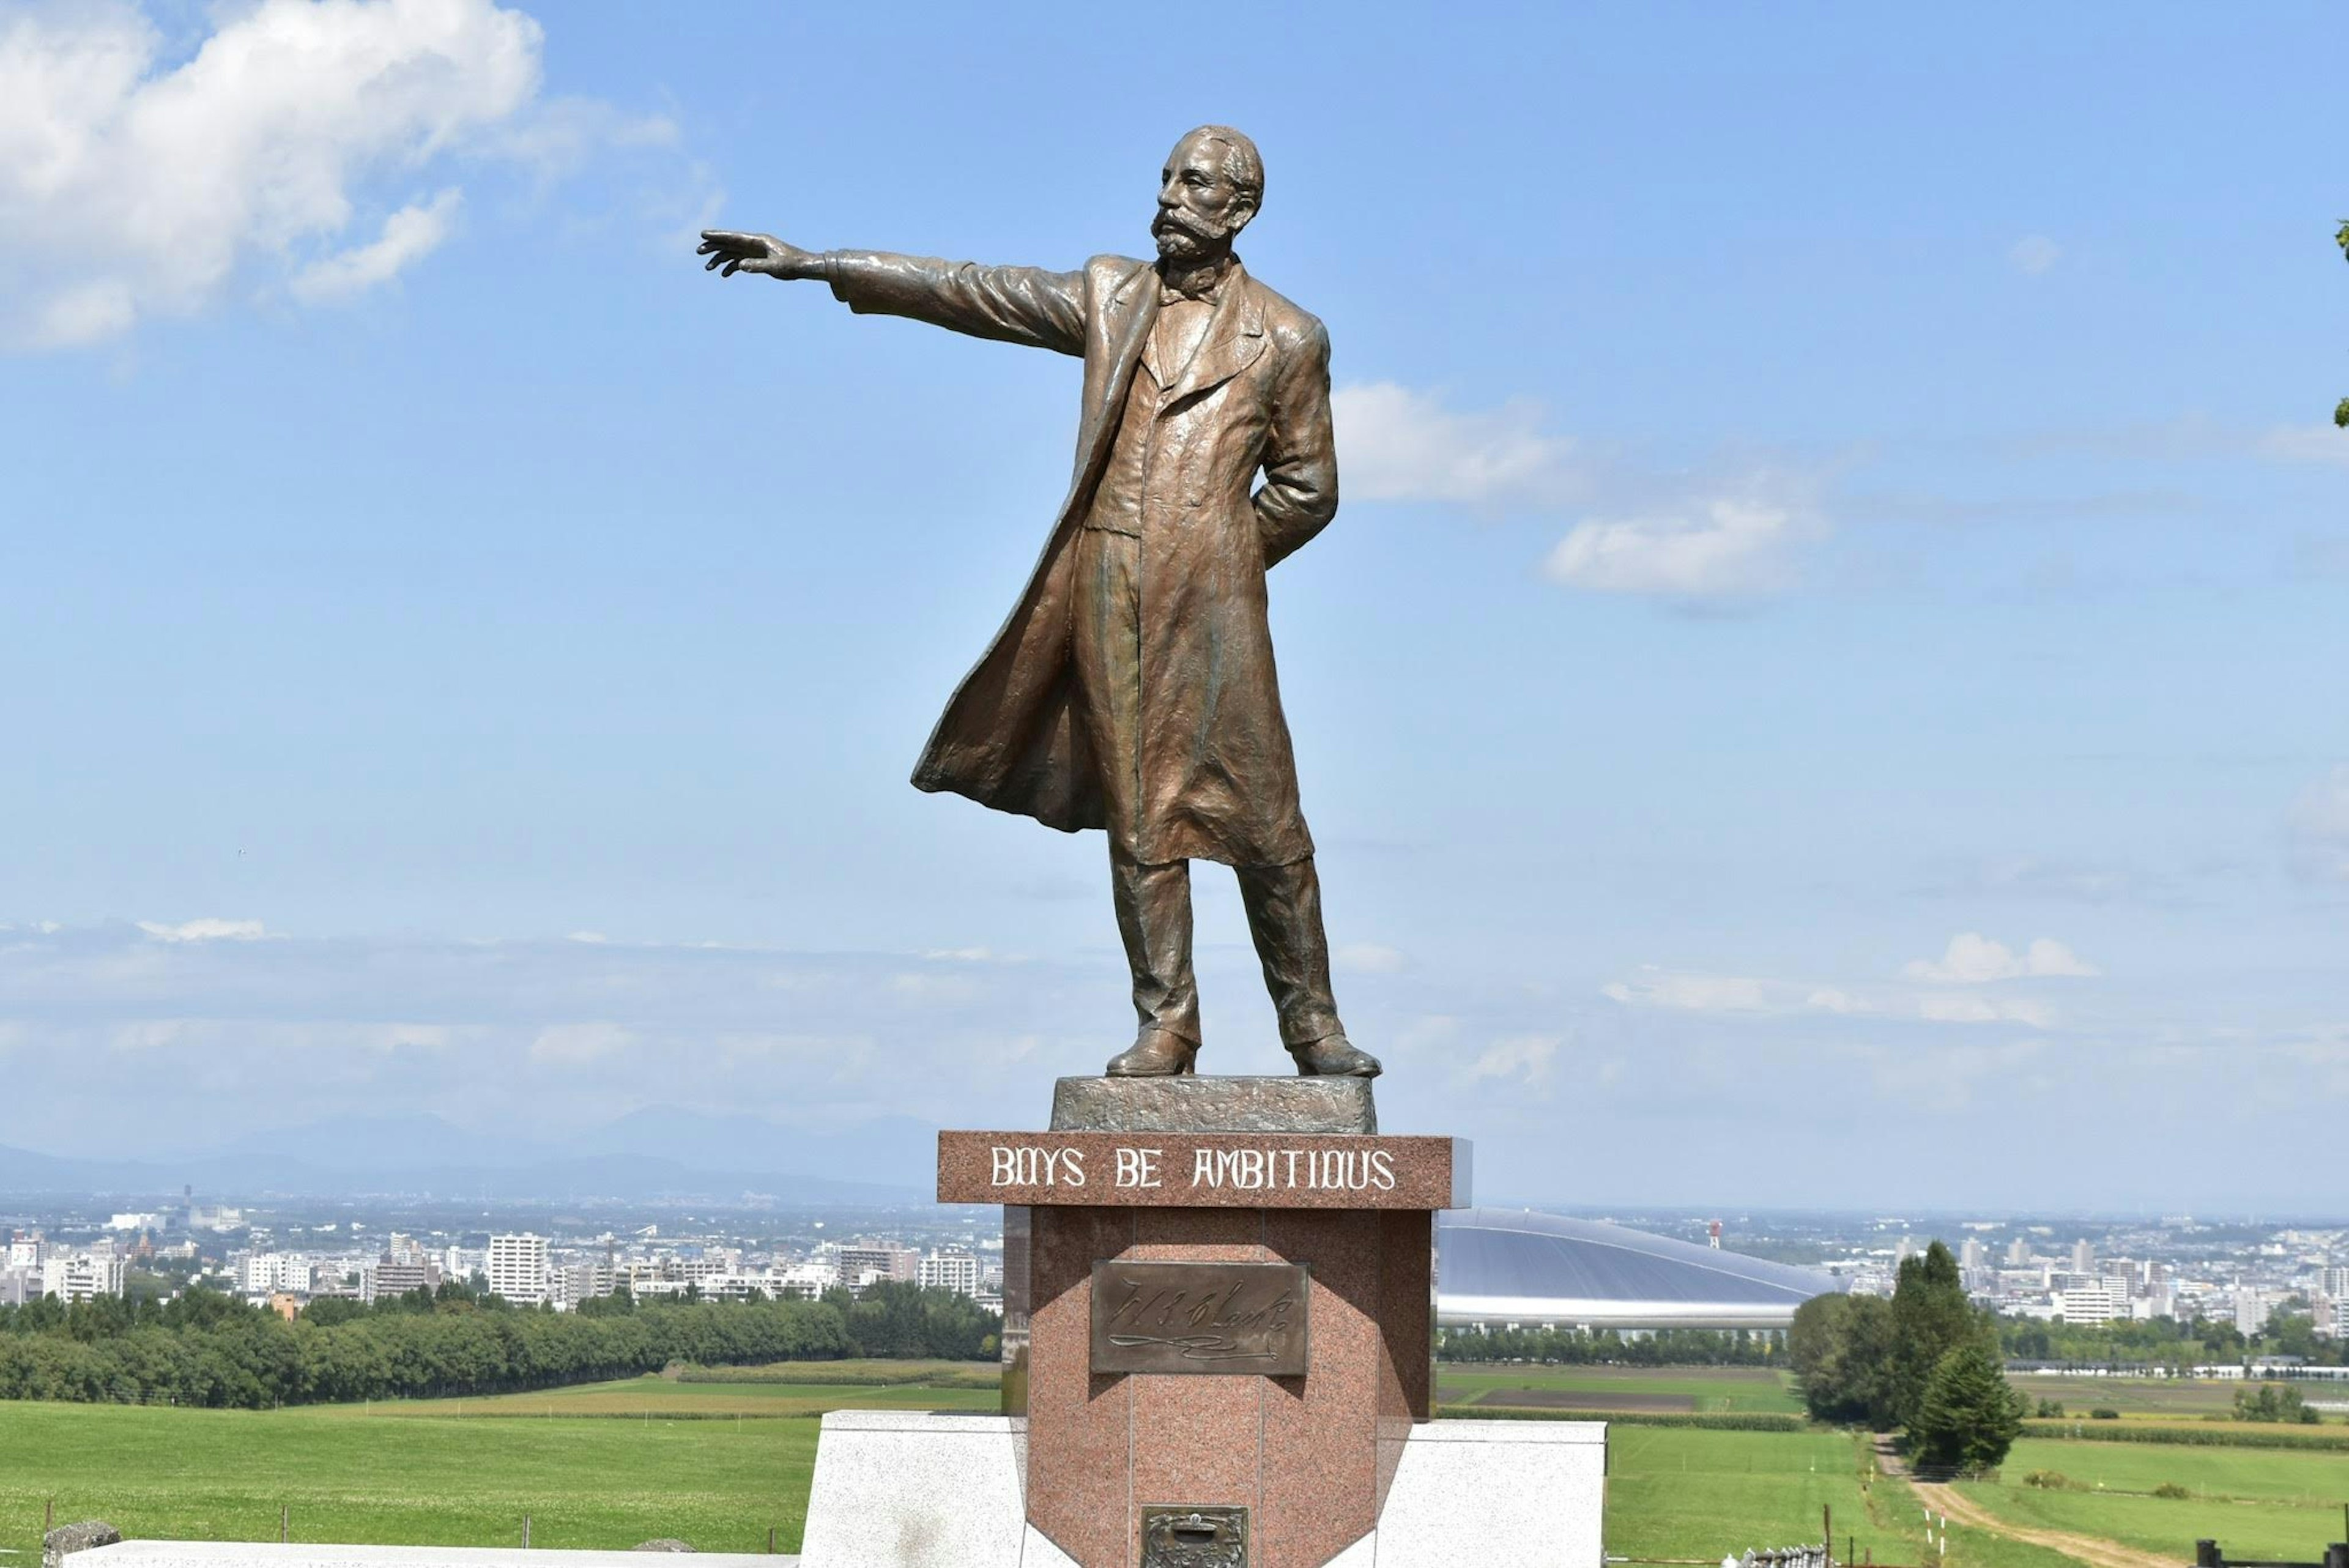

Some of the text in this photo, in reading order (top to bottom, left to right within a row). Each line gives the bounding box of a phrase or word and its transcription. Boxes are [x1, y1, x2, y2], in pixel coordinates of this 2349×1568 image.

[992, 1146, 1395, 1191] BOYS BE AMBITIOUS
